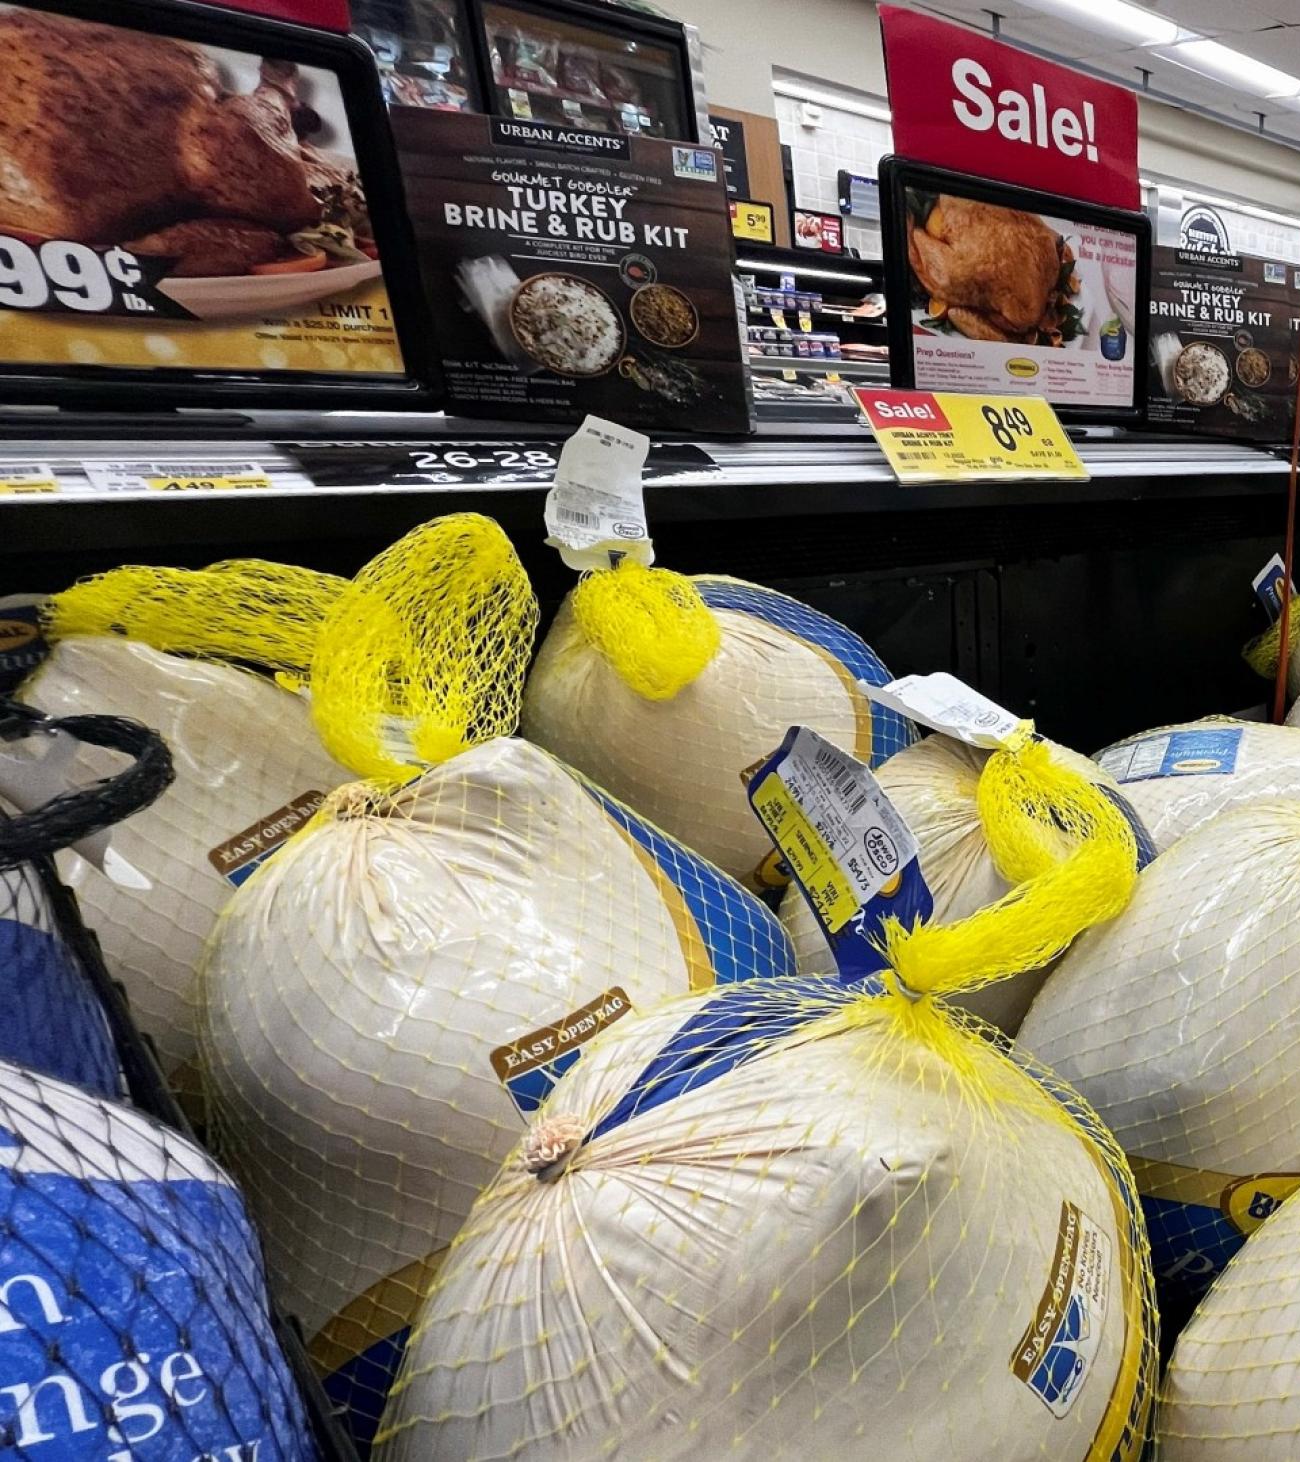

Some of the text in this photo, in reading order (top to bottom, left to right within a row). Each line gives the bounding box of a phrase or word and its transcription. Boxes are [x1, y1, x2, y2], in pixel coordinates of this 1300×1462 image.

[951, 58, 1100, 162] Sale!
[500, 124, 552, 141] URBAN
[557, 131, 621, 150] ACCENTS
[709, 124, 730, 141] AT
[491, 170, 563, 188] GOURMET
[508, 186, 627, 219] TURKEY
[444, 202, 689, 249] BRINE & RUB KIT
[1179, 251, 1206, 262] URBAN
[122, 293, 154, 312] lb.
[320, 303, 388, 320] LIMIT 1
[1181, 290, 1241, 309] TURKEY
[1150, 301, 1272, 327] BRINE & RUB KIT
[917, 347, 976, 360] Prep Questions?
[874, 400, 936, 420] Sale!
[409, 450, 557, 469] 26-28
[220, 832, 265, 864] EASY
[262, 812, 302, 839] OPEN
[871, 829, 897, 864] Jewel
[866, 838, 890, 869] Osco
[504, 996, 624, 1068] EASY OPEN BAG
[1078, 1230, 1092, 1288] No Knives
[1021, 1212, 1077, 1364] EASY OPEN BAG
